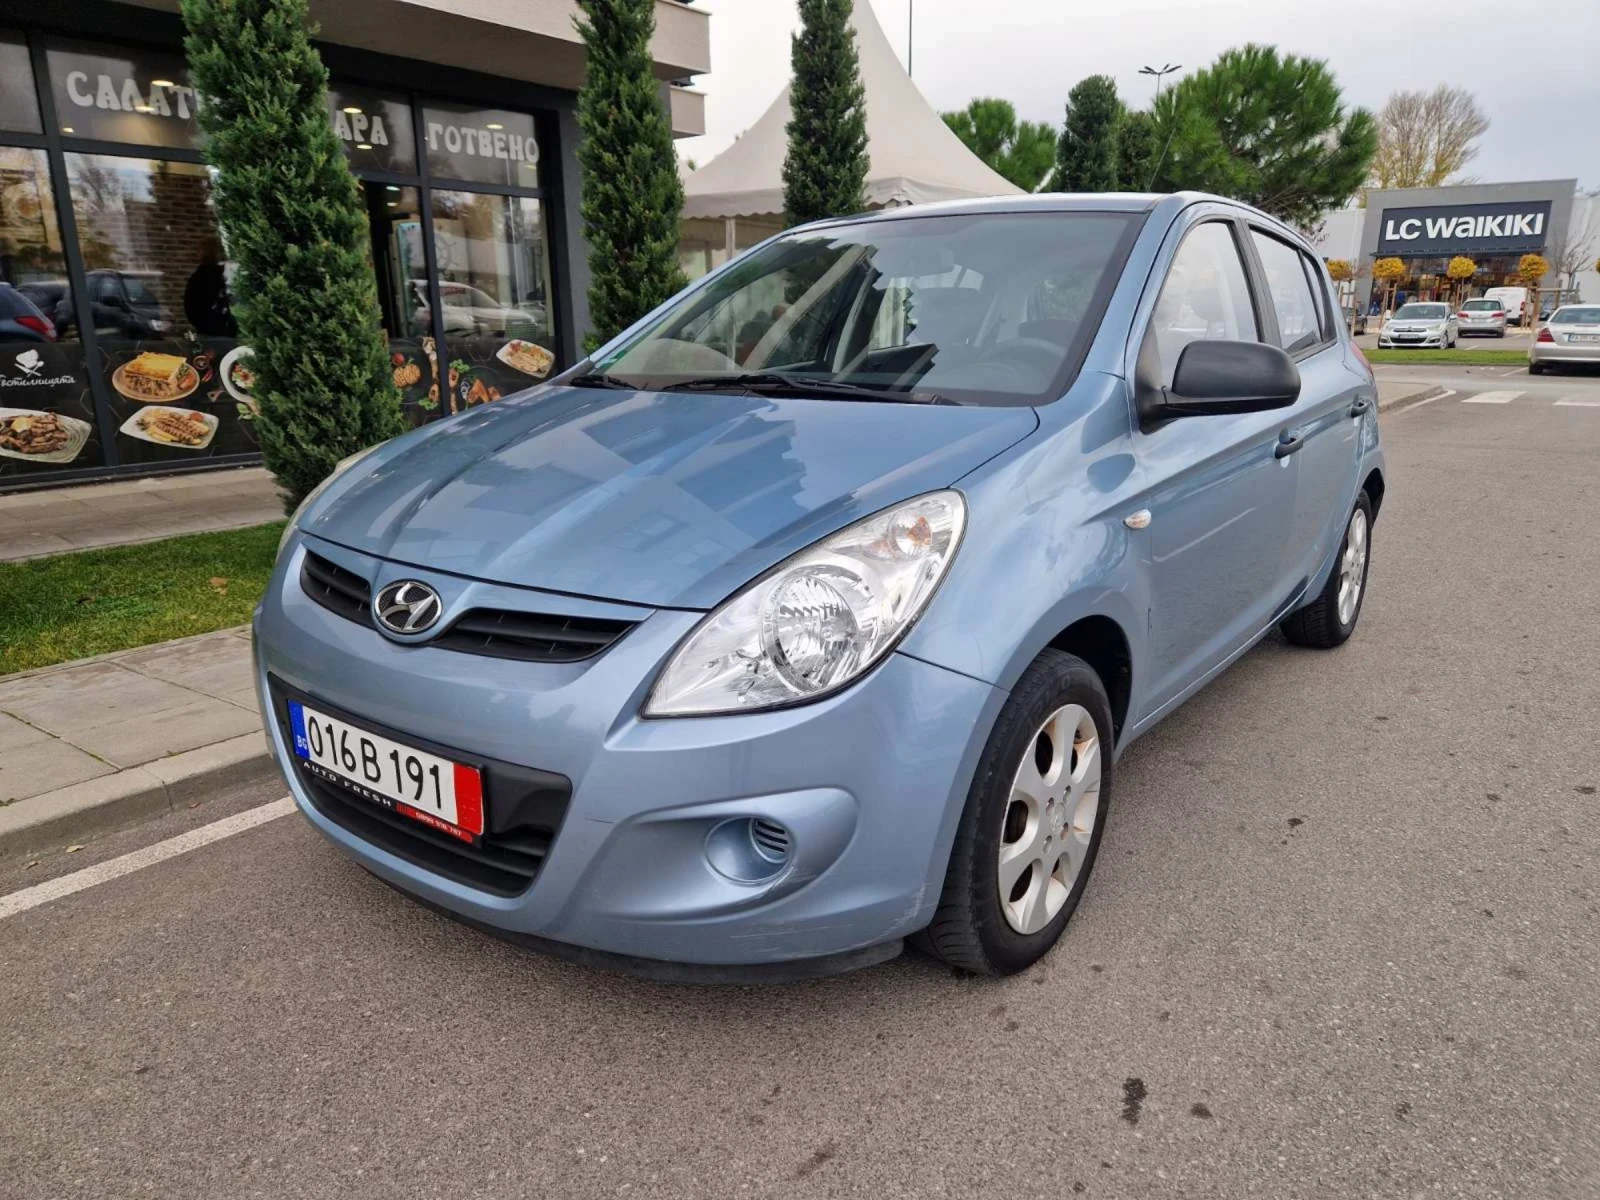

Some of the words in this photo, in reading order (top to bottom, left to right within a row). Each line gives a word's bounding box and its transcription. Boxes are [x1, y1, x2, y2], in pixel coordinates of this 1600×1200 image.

[334, 109, 389, 146] АРА
[427, 122, 540, 163] ГОТВЕНО
[1385, 218, 1422, 241] LC
[297, 734, 309, 750] BG
[303, 761, 338, 782] AUTO
[344, 781, 392, 808] FRESH
